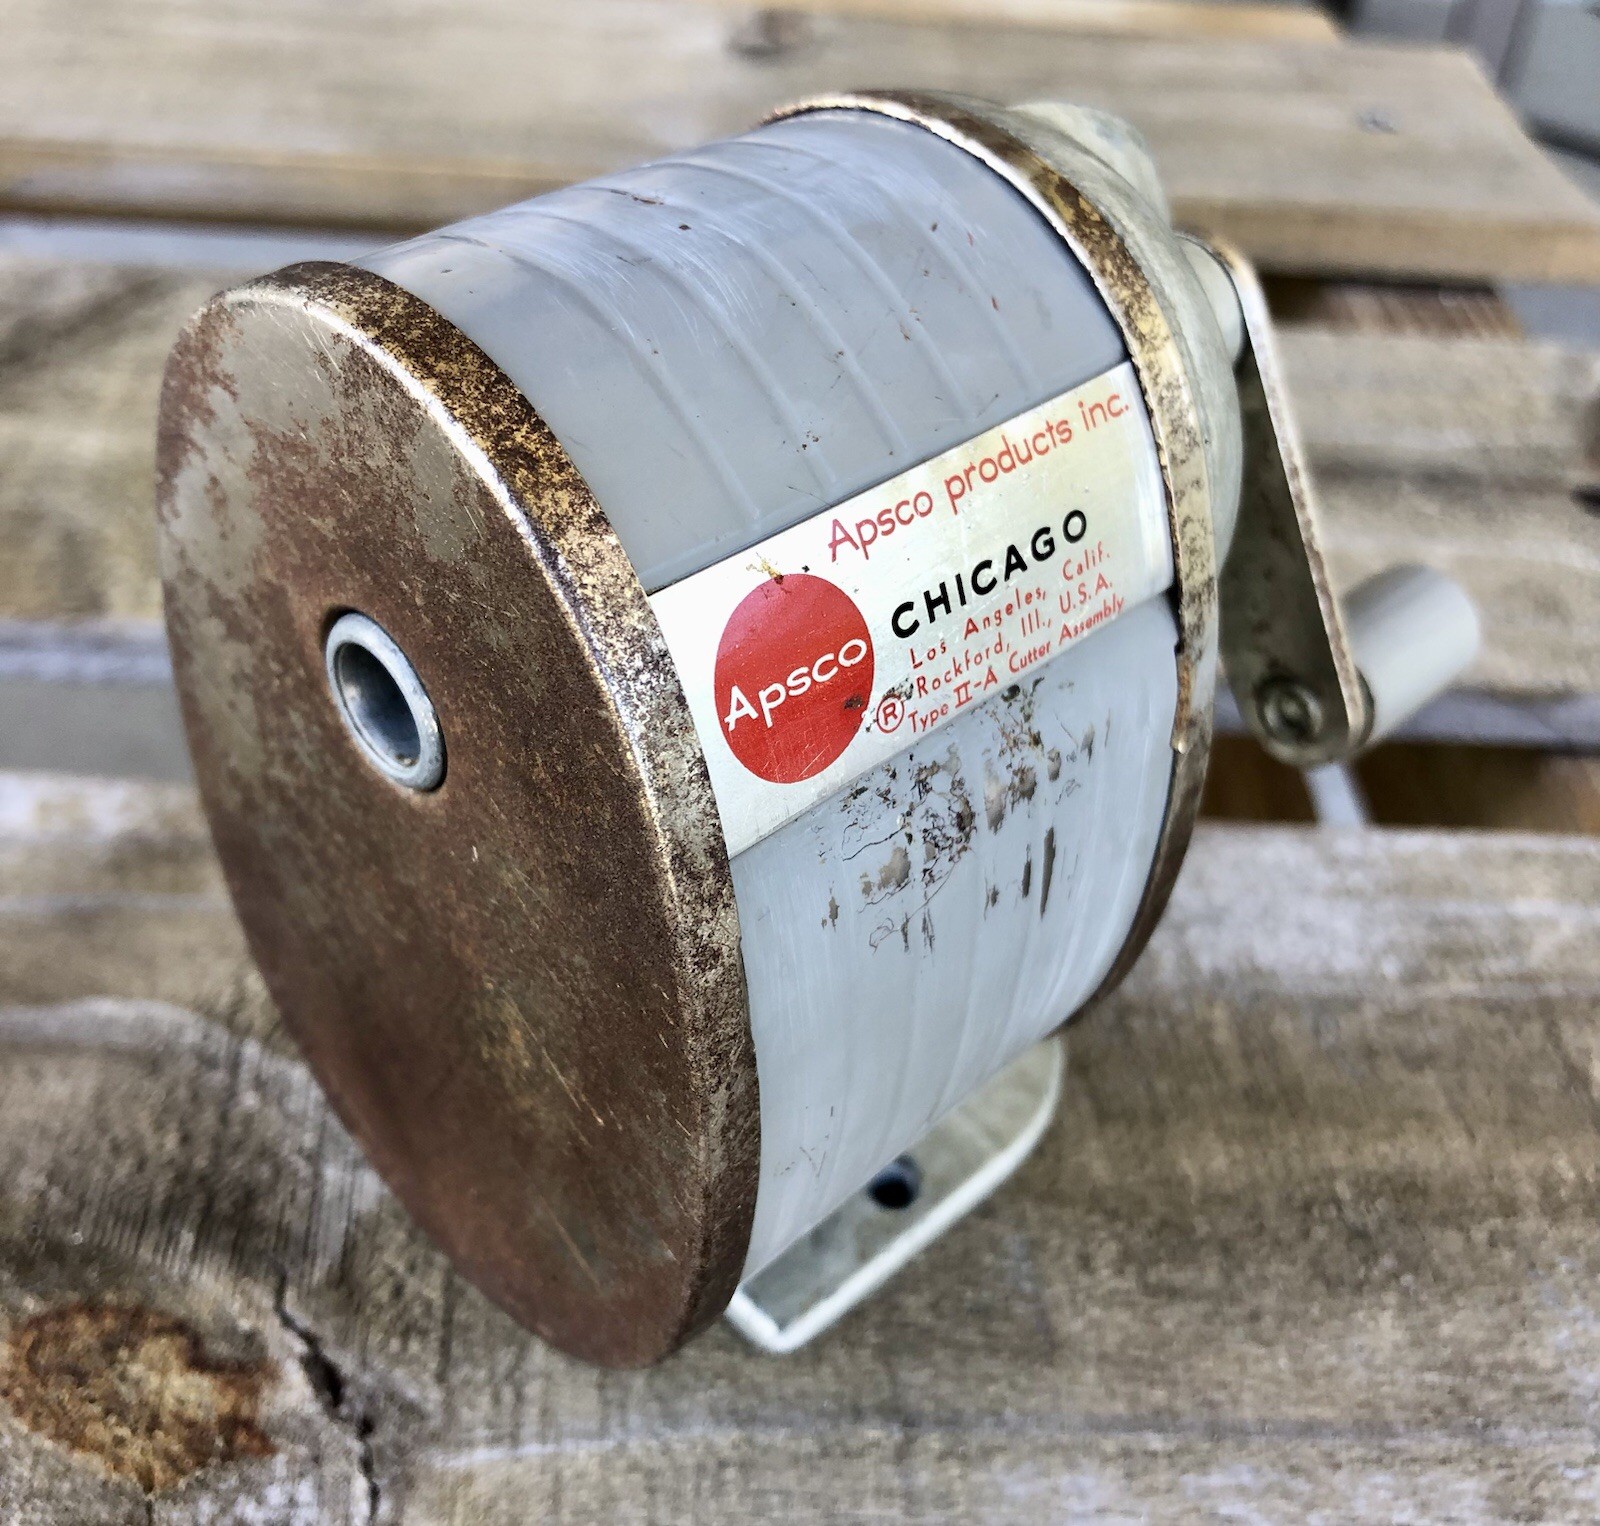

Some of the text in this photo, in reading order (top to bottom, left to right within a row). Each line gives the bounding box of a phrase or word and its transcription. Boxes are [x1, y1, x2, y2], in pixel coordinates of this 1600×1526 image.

[828, 393, 1129, 563] Apsco products inc.
[891, 509, 1087, 639] CHICAGO
[909, 541, 1111, 669] Los Angeles, Calif.
[916, 633, 1010, 698] Rockford,
[1059, 573, 1113, 614] U.S.A.
[723, 638, 867, 731] Apsco
[908, 702, 949, 733] Type
[1008, 640, 1051, 673] Cutter
[1058, 594, 1125, 645] Assembly
